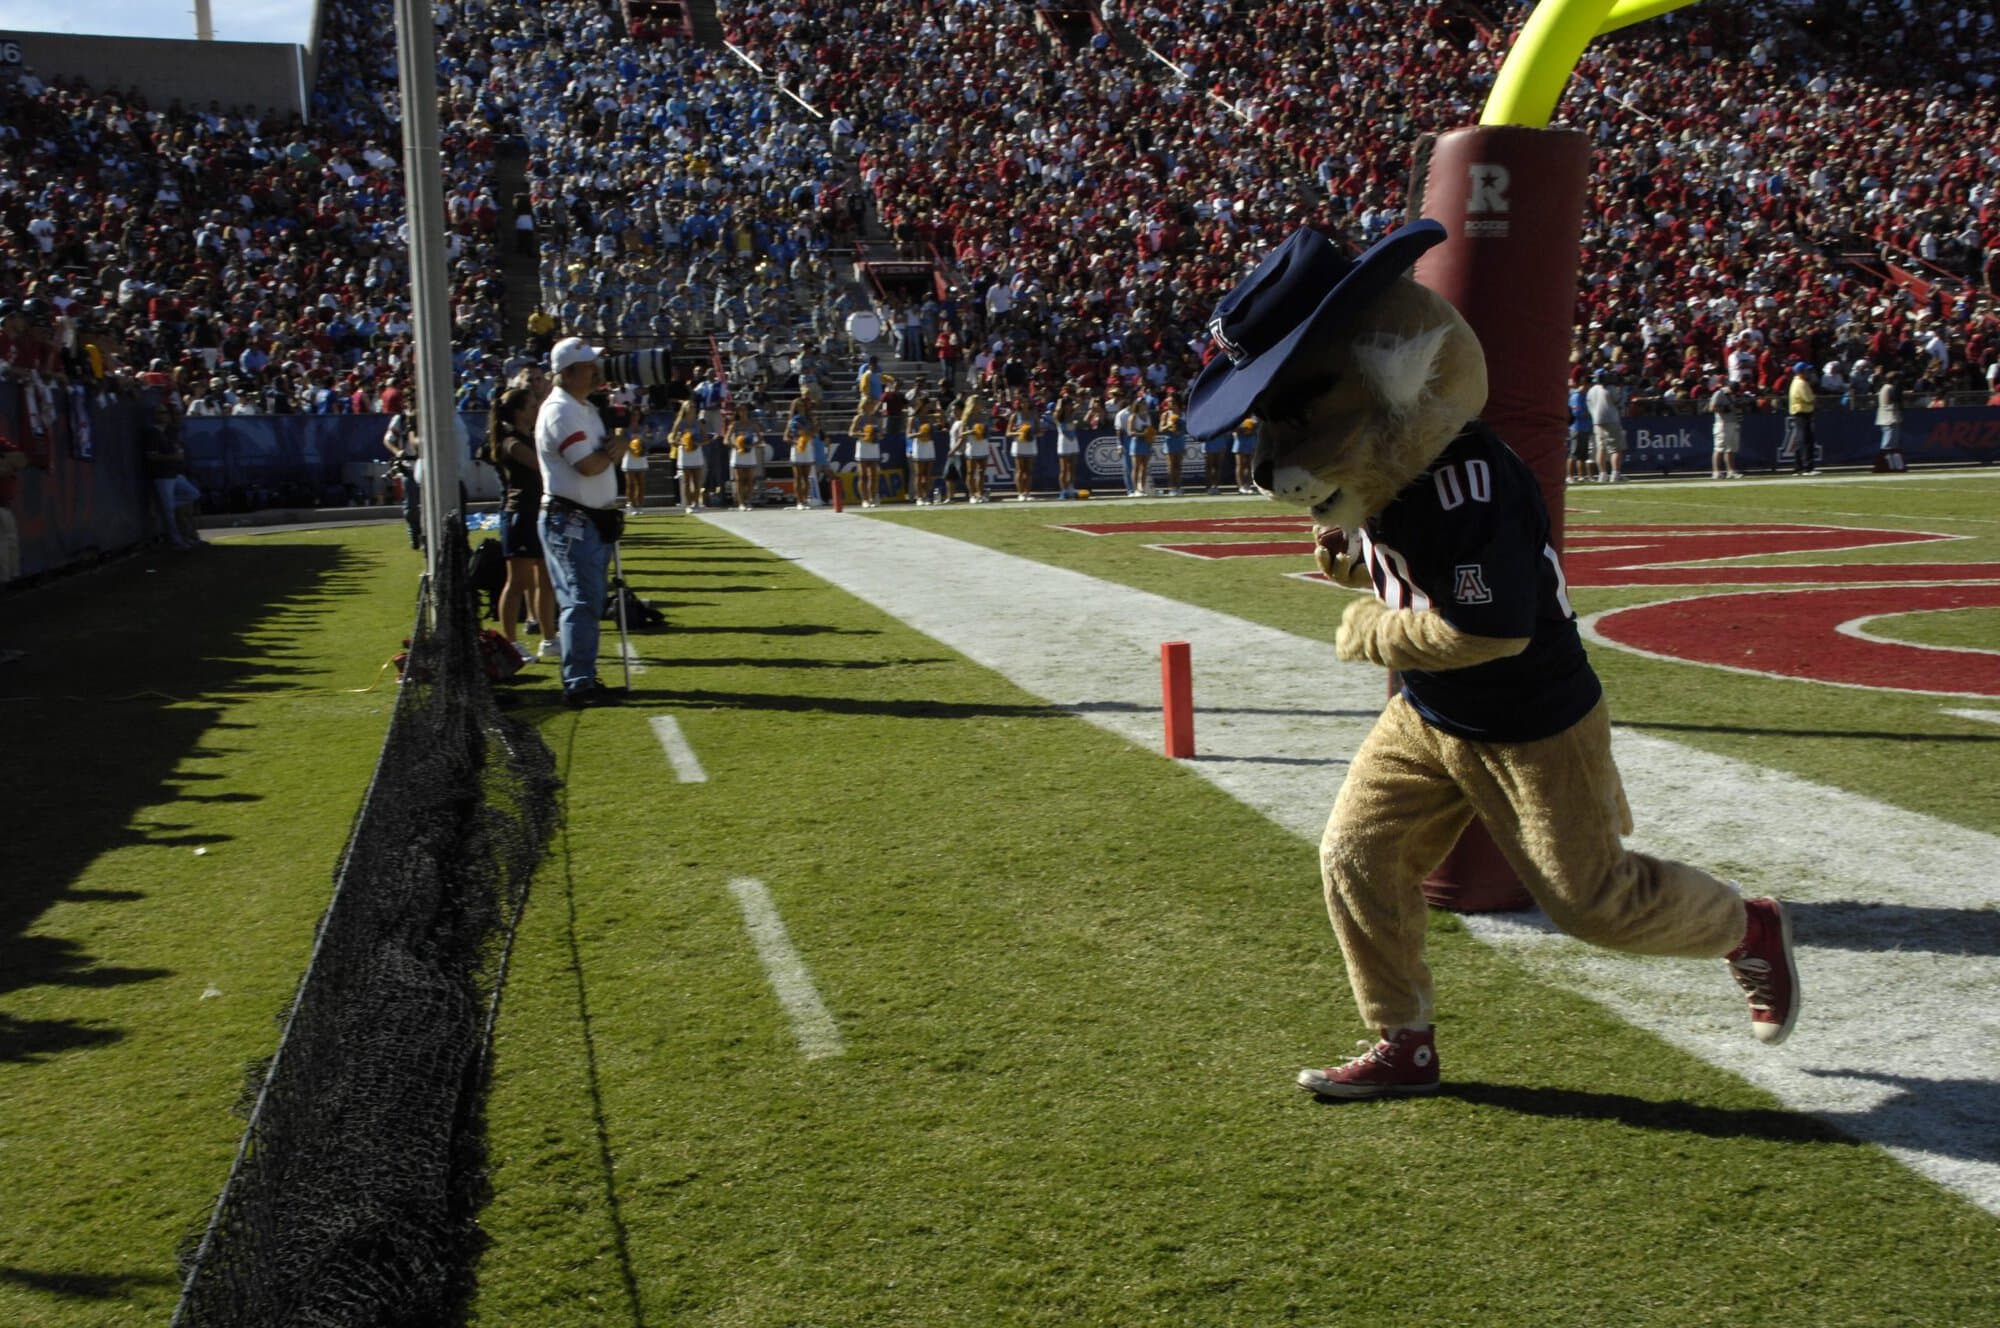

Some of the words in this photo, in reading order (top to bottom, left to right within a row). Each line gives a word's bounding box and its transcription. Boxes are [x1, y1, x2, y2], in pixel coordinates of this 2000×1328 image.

[1466, 164, 1510, 212] R
[1636, 428, 1692, 449] Bank
[1433, 459, 1491, 511] 00
[1453, 564, 1493, 605] A
